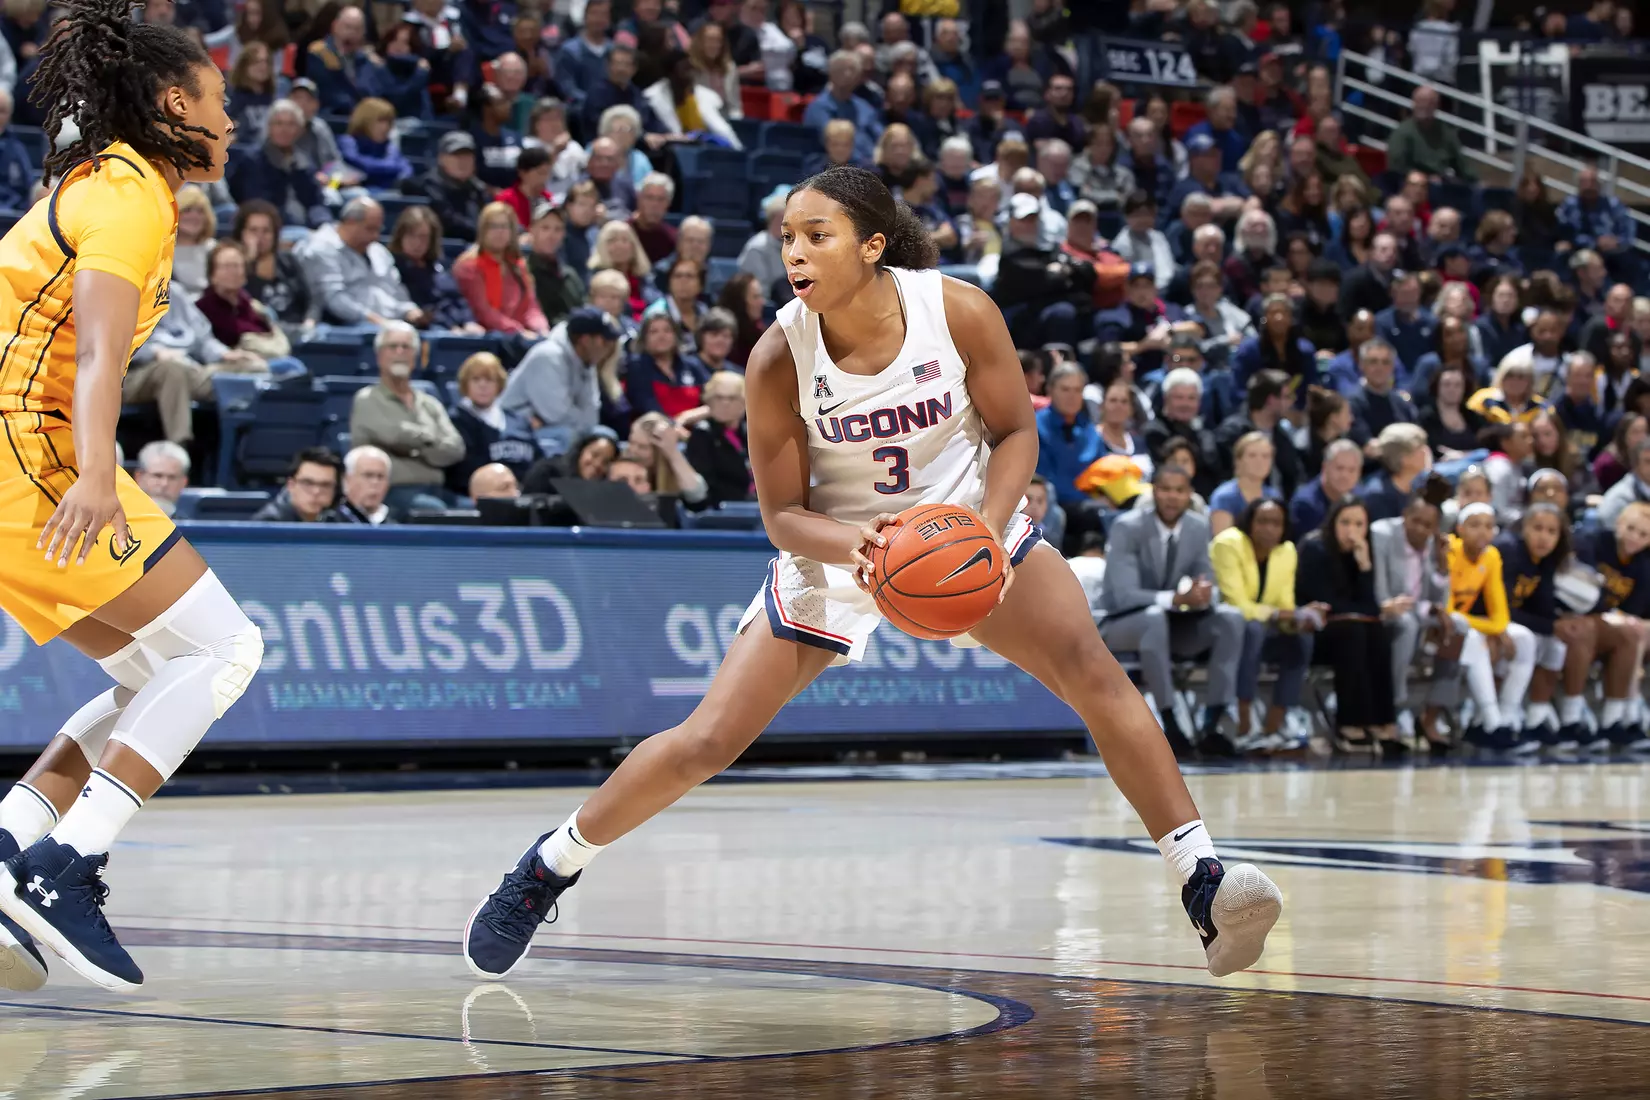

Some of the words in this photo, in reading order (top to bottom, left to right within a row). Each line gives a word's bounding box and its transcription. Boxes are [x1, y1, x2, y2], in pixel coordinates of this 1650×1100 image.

[1144, 48, 1197, 84] 124
[1583, 84, 1650, 119] BE
[815, 391, 953, 443] UCONN
[872, 446, 910, 495] 3
[109, 524, 141, 567] Cl
[917, 514, 977, 542] ELITE
[240, 573, 582, 672] enius3D
[266, 683, 497, 711] MAMMOGRAPHY
[504, 679, 581, 710] EXAM
